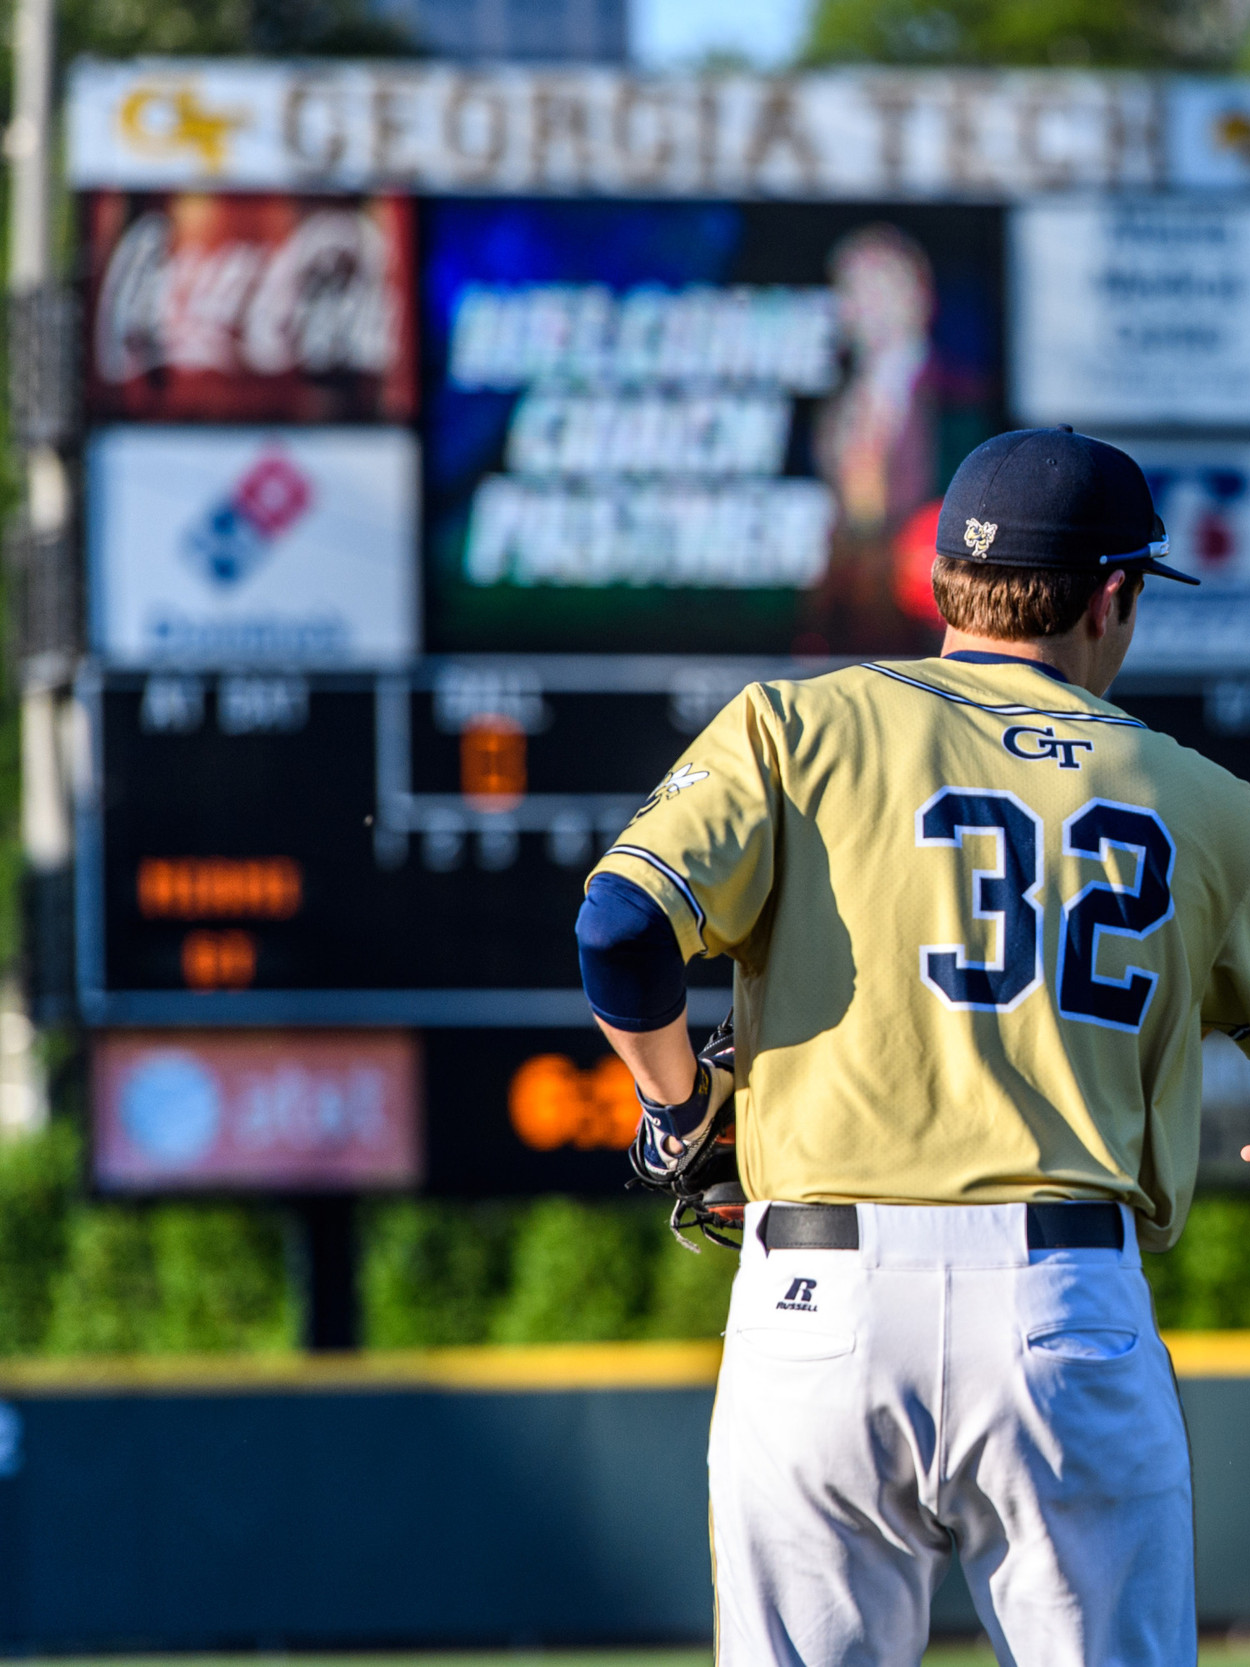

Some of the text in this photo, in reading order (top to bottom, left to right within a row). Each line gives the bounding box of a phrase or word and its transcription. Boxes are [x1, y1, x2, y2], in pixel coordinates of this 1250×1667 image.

[281, 78, 1166, 196] GEORGIA TECH
[450, 282, 840, 392] WELCOME
[1003, 726, 1093, 769] GT
[914, 785, 1176, 1034] 32
[775, 1301, 818, 1312] RUSSELL
